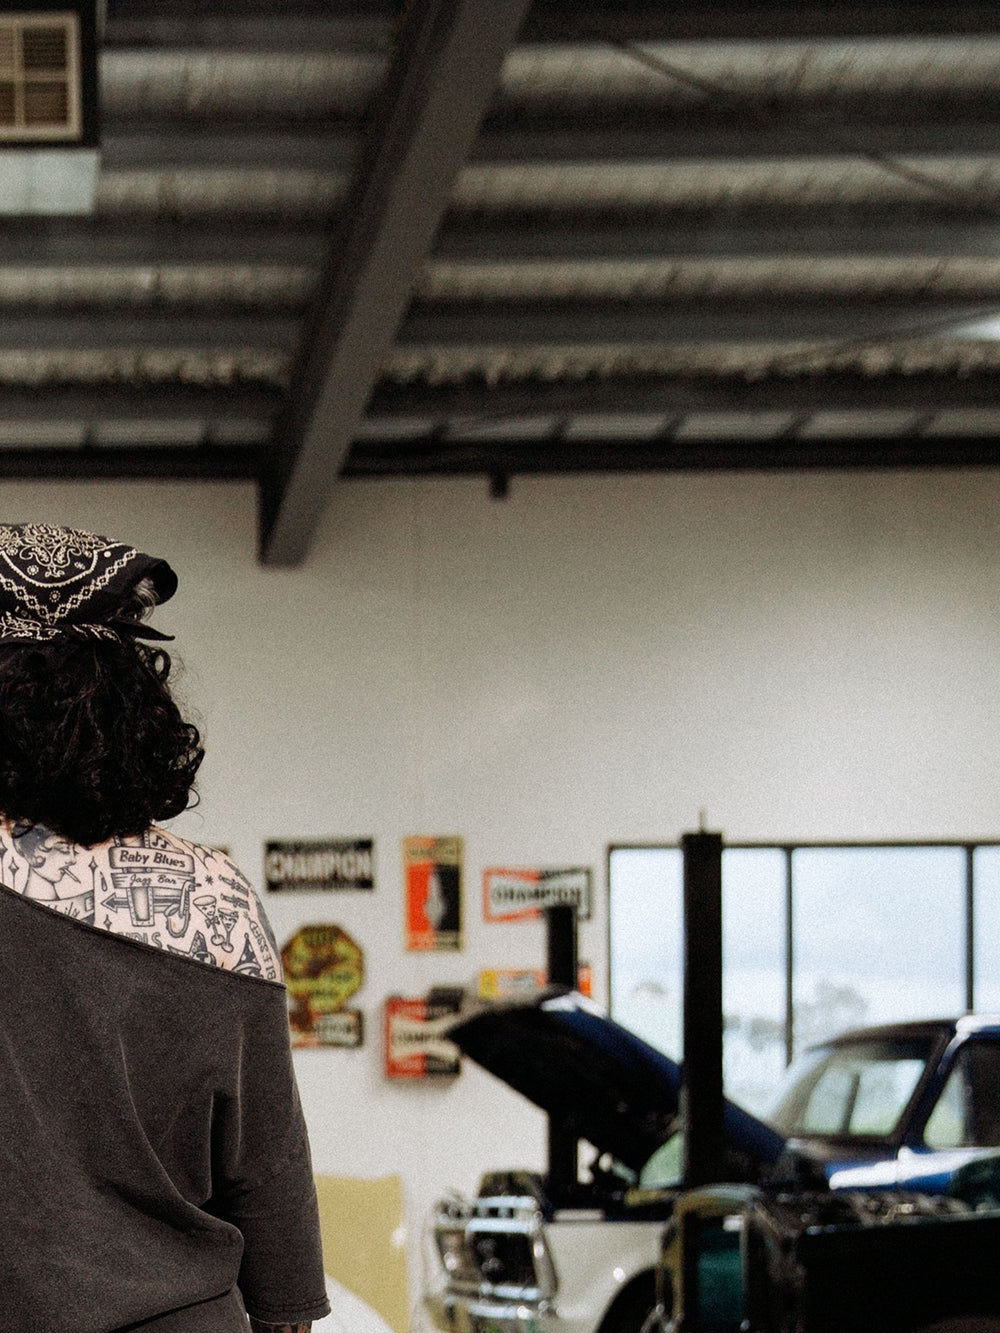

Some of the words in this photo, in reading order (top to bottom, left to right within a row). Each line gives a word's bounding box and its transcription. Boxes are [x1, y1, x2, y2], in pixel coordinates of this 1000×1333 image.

[120, 850, 149, 864] Baby
[153, 852, 185, 868] Blues
[265, 852, 371, 881] CHAMPION
[157, 874, 177, 884] Bar
